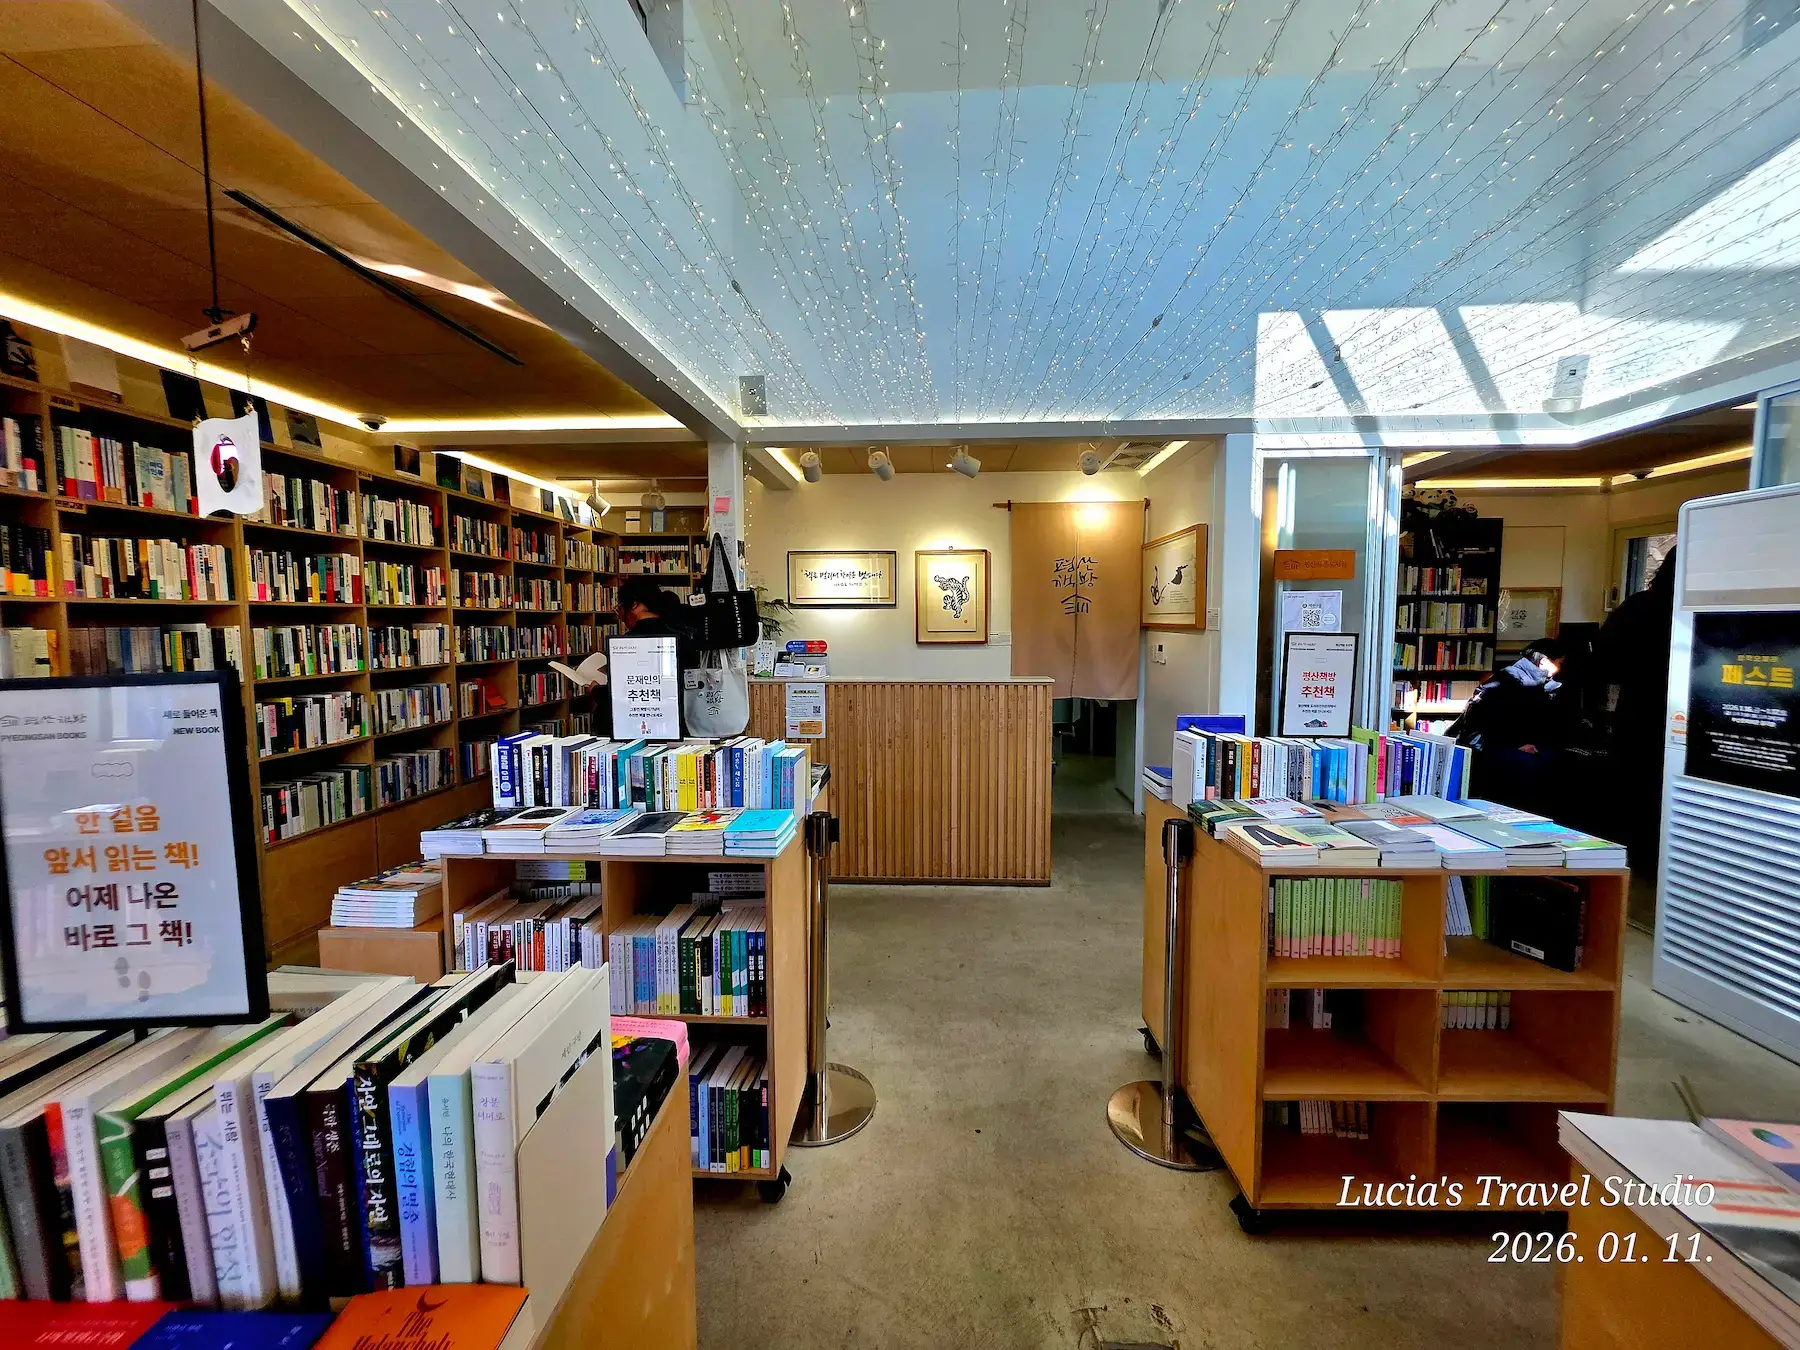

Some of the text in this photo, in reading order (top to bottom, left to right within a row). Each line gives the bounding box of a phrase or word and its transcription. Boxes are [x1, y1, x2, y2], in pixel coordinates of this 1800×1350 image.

[1054, 556, 1098, 572] 평산
[1051, 572, 1098, 587] 책방
[627, 675, 661, 685] 문재인의
[1303, 671, 1336, 681] 평산책방
[1721, 664, 1793, 688] 페스트
[628, 689, 661, 701] 추천책
[1301, 685, 1335, 698] 추천책
[163, 708, 218, 719] 새로 들어온 책
[0, 731, 87, 742] PYEONGSAN BOOKS
[173, 726, 220, 735] NEW BOOK
[109, 804, 160, 833] 걸음
[43, 841, 199, 874] 앞서 읽는 책!
[66, 882, 179, 912] 어제 나온
[64, 919, 193, 952] 바로 그 책!
[220, 1091, 239, 1143] 뛰는 사람
[441, 1125, 454, 1147] 나의
[357, 1076, 388, 1223] 자연 그대로의 자연
[397, 1142, 417, 1190] 경험의
[442, 1149, 457, 1200] 한국현대사
[396, 1311, 433, 1338] The
